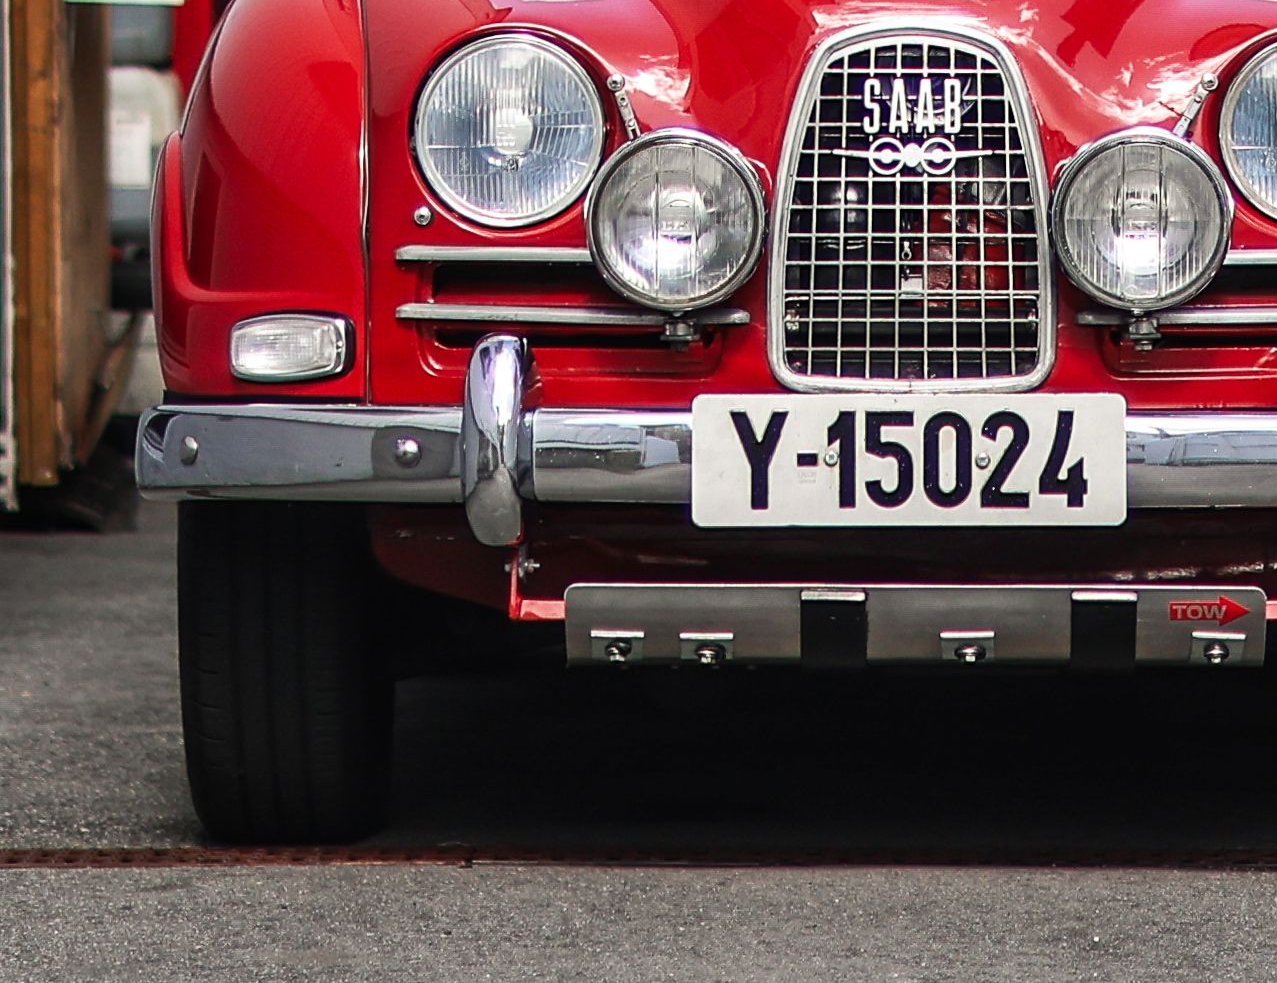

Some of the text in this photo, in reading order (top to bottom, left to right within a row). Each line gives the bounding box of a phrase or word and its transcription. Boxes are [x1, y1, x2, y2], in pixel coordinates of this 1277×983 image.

[863, 77, 961, 135] SAAB
[729, 410, 1089, 510] Y-15024
[1172, 604, 1228, 620] TOW
